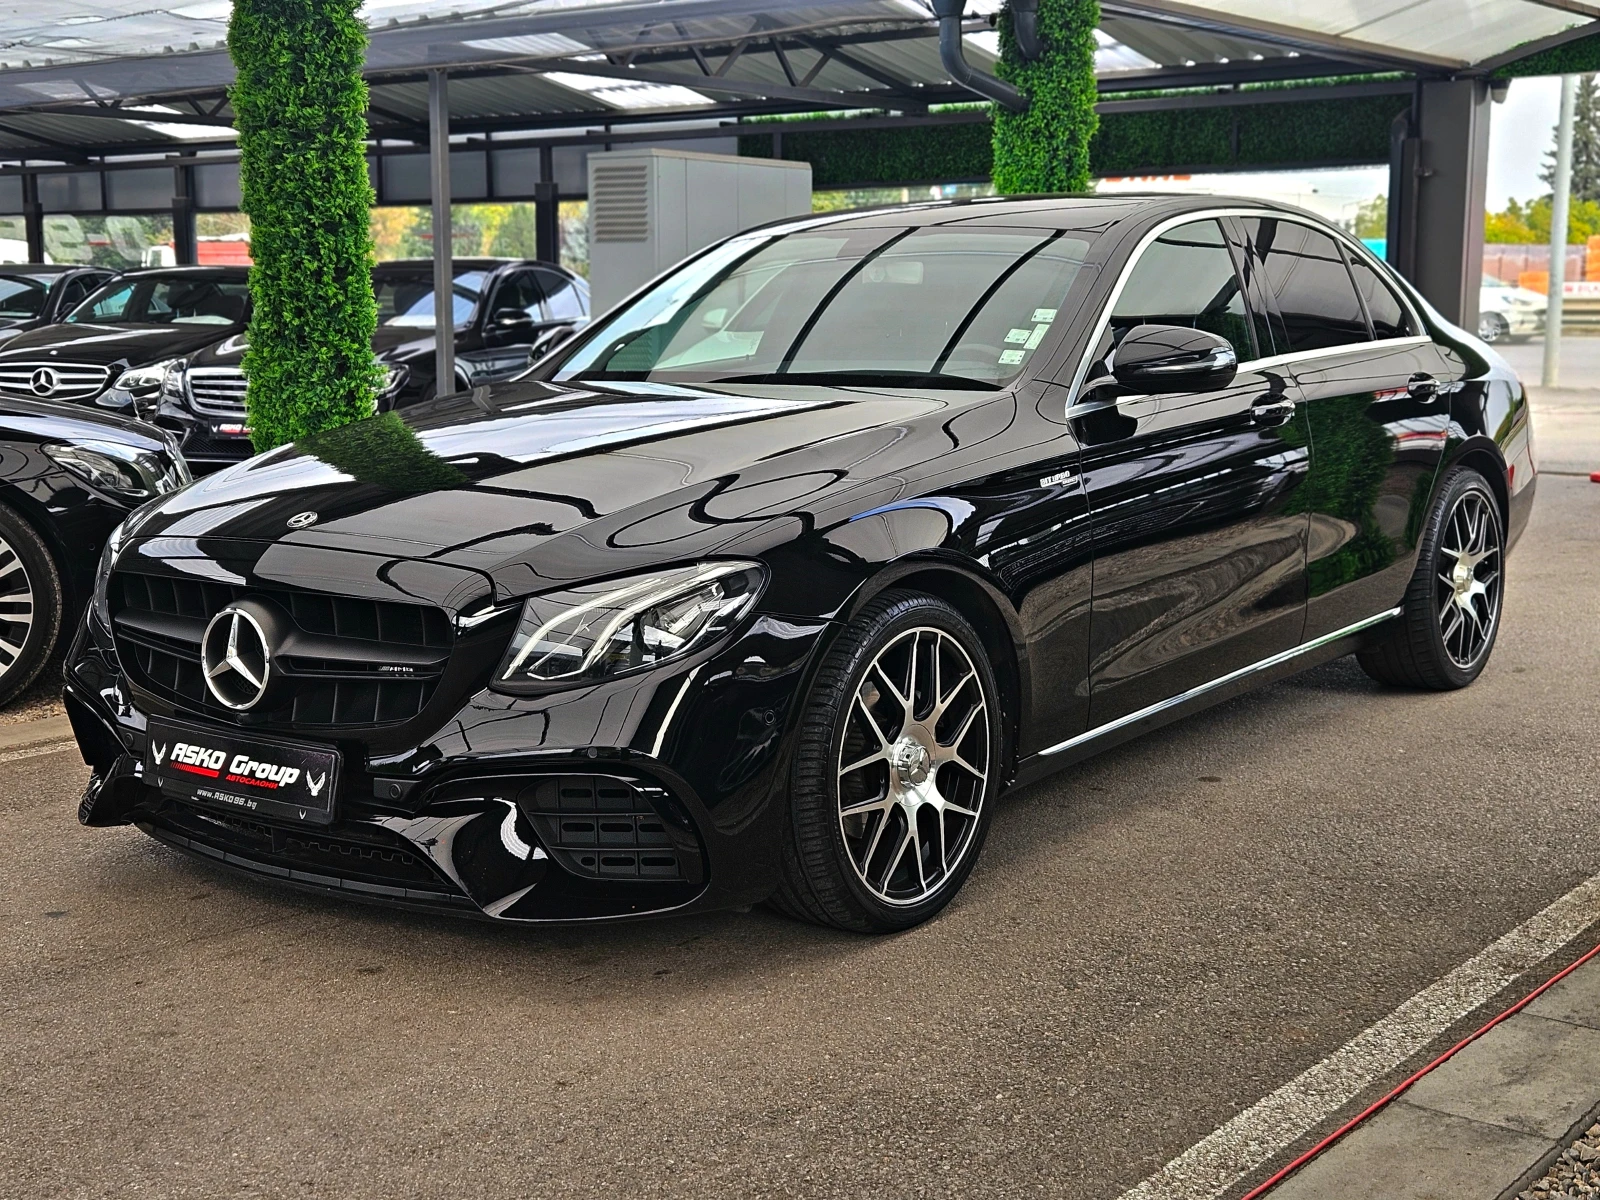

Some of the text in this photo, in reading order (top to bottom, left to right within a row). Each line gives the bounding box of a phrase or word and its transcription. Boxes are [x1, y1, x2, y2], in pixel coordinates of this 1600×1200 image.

[170, 742, 301, 787] ASKO Group
[225, 774, 279, 790] АВТОСАЛОНИ
